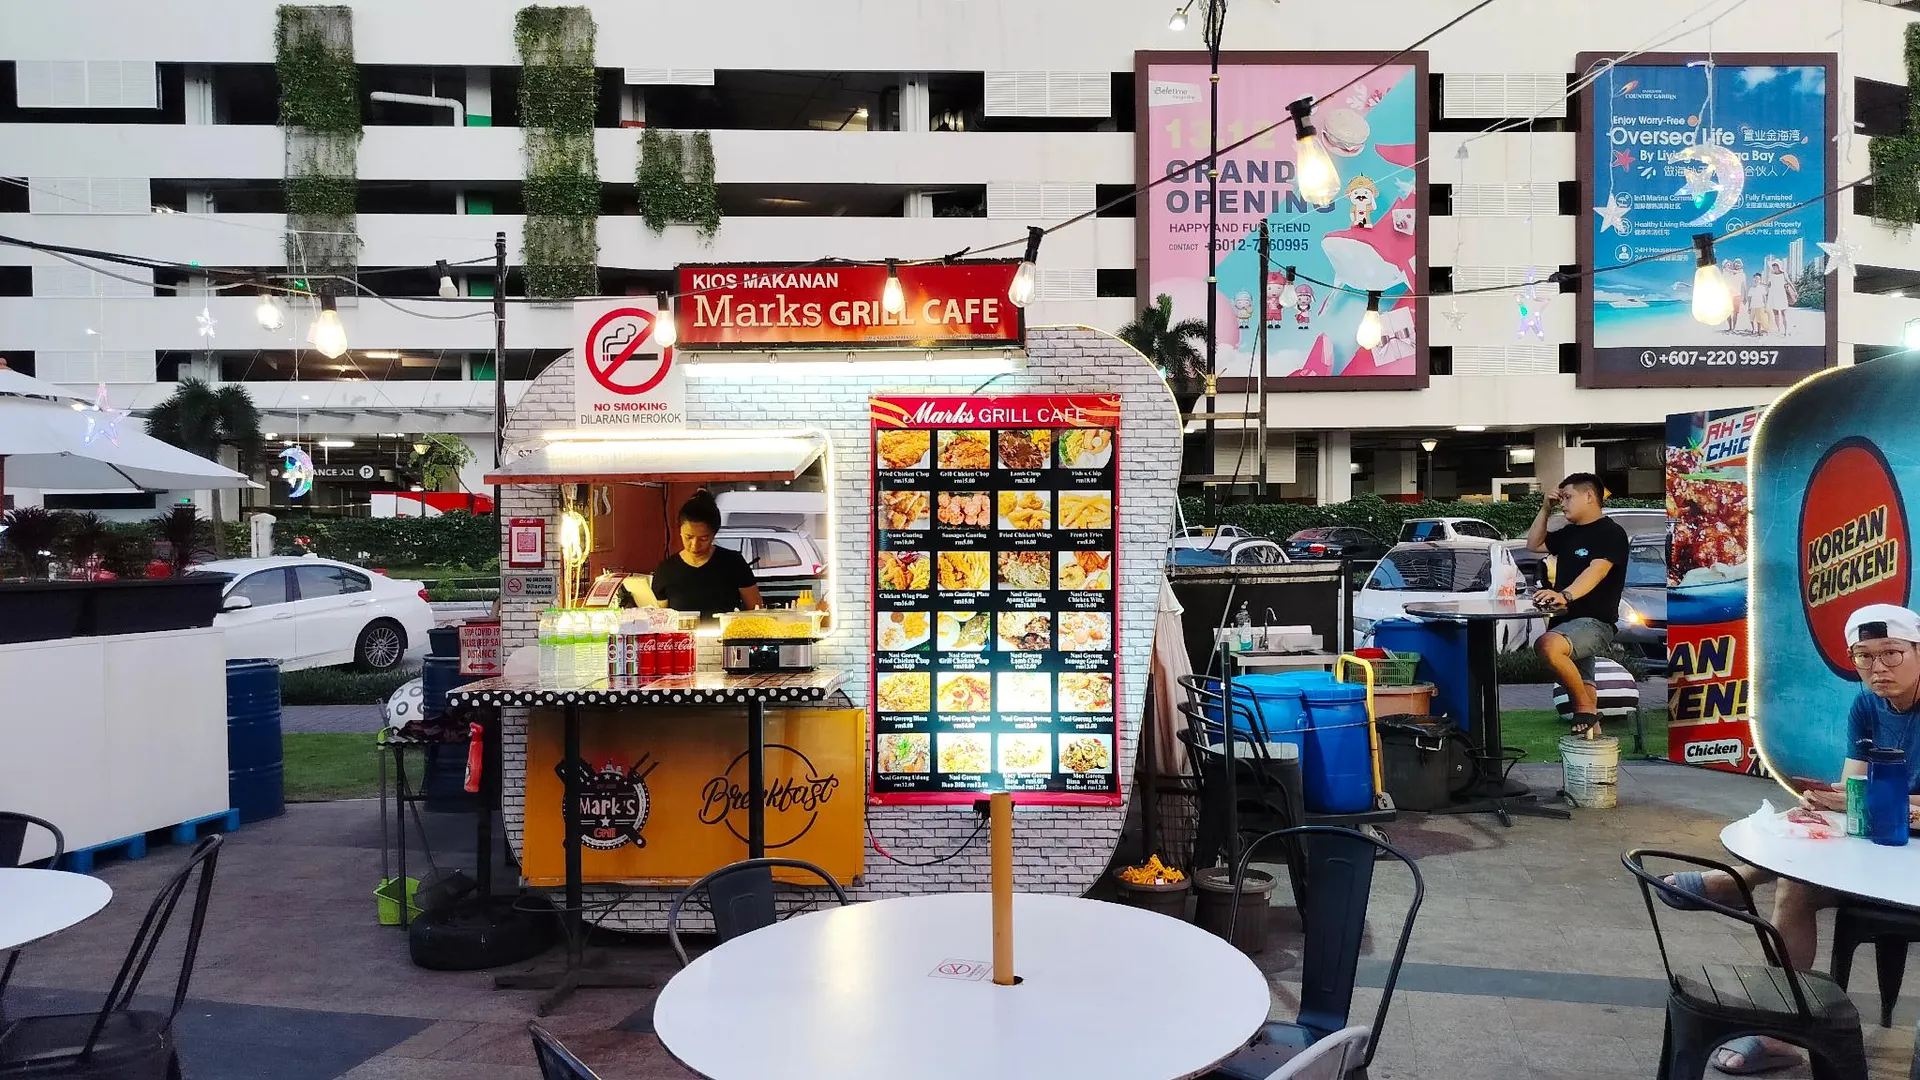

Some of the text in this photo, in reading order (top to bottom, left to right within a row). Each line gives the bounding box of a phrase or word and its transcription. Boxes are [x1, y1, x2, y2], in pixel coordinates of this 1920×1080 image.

[1613, 115, 1685, 126] Enjoy Worry-Free
[1611, 126, 1735, 146] Oversea Life
[1640, 150, 1654, 163] By
[1752, 149, 1775, 163] Bay
[1166, 160, 1298, 184] GRAND
[1169, 222, 1311, 233] HAPPY AND FU TREND
[1169, 239, 1309, 252] CONTACT +6012-760995
[692, 273, 838, 290] KIOS MAKANAN
[694, 294, 999, 328] Marks GRILL CAFE
[1659, 351, 1779, 366] +607-220 9957
[594, 402, 668, 412] NO SMOKING
[903, 402, 1088, 425] Marks GRILL CAFE
[580, 413, 681, 425] DILARANG MEROKOK
[1808, 505, 1886, 573] KOREAN
[1808, 538, 1898, 607] CHICKEN!
[475, 628, 491, 636] COVID
[493, 628, 500, 636] 19
[491, 637, 501, 647] SA
[467, 649, 497, 658] DISTANCE
[1686, 743, 1738, 757] Chicken
[699, 773, 839, 824] Brekfast
[580, 797, 636, 815] Mark's
[593, 828, 617, 838] Grill
